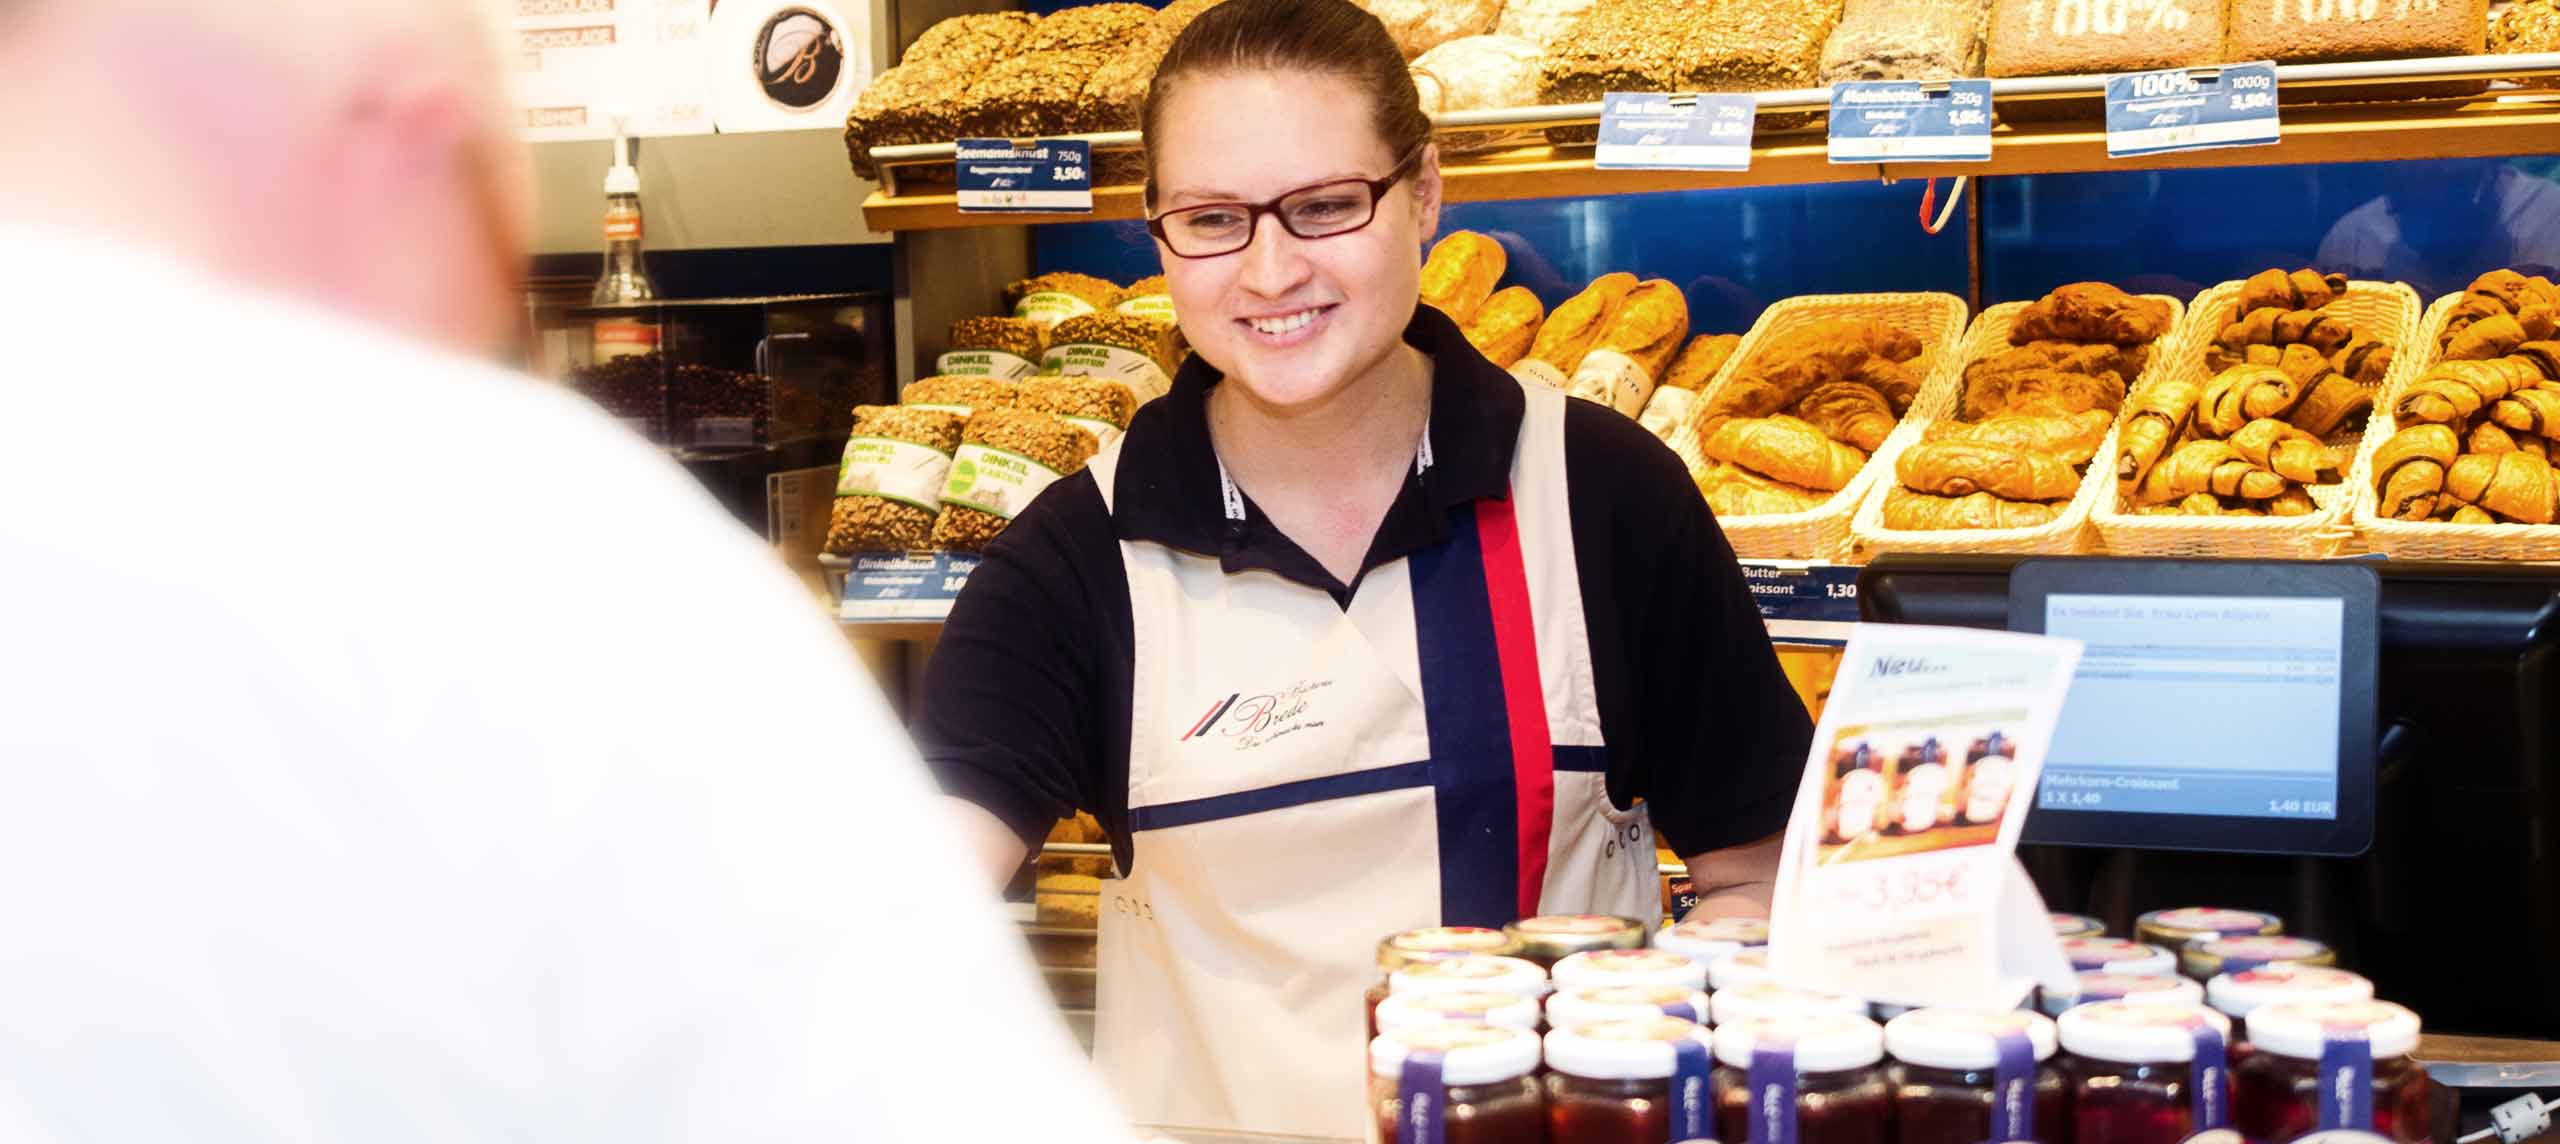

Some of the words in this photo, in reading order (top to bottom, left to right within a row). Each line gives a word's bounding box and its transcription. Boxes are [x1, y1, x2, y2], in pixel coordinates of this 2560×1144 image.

[2131, 71, 2200, 97] 100%
[2232, 75, 2270, 90] 1000g
[1057, 151, 1082, 165] 750g
[947, 355, 993, 366] DINKEL
[1066, 347, 1109, 359] DINKEL
[980, 452, 1030, 476] DINKEL
[1825, 583, 1857, 599] 1,30
